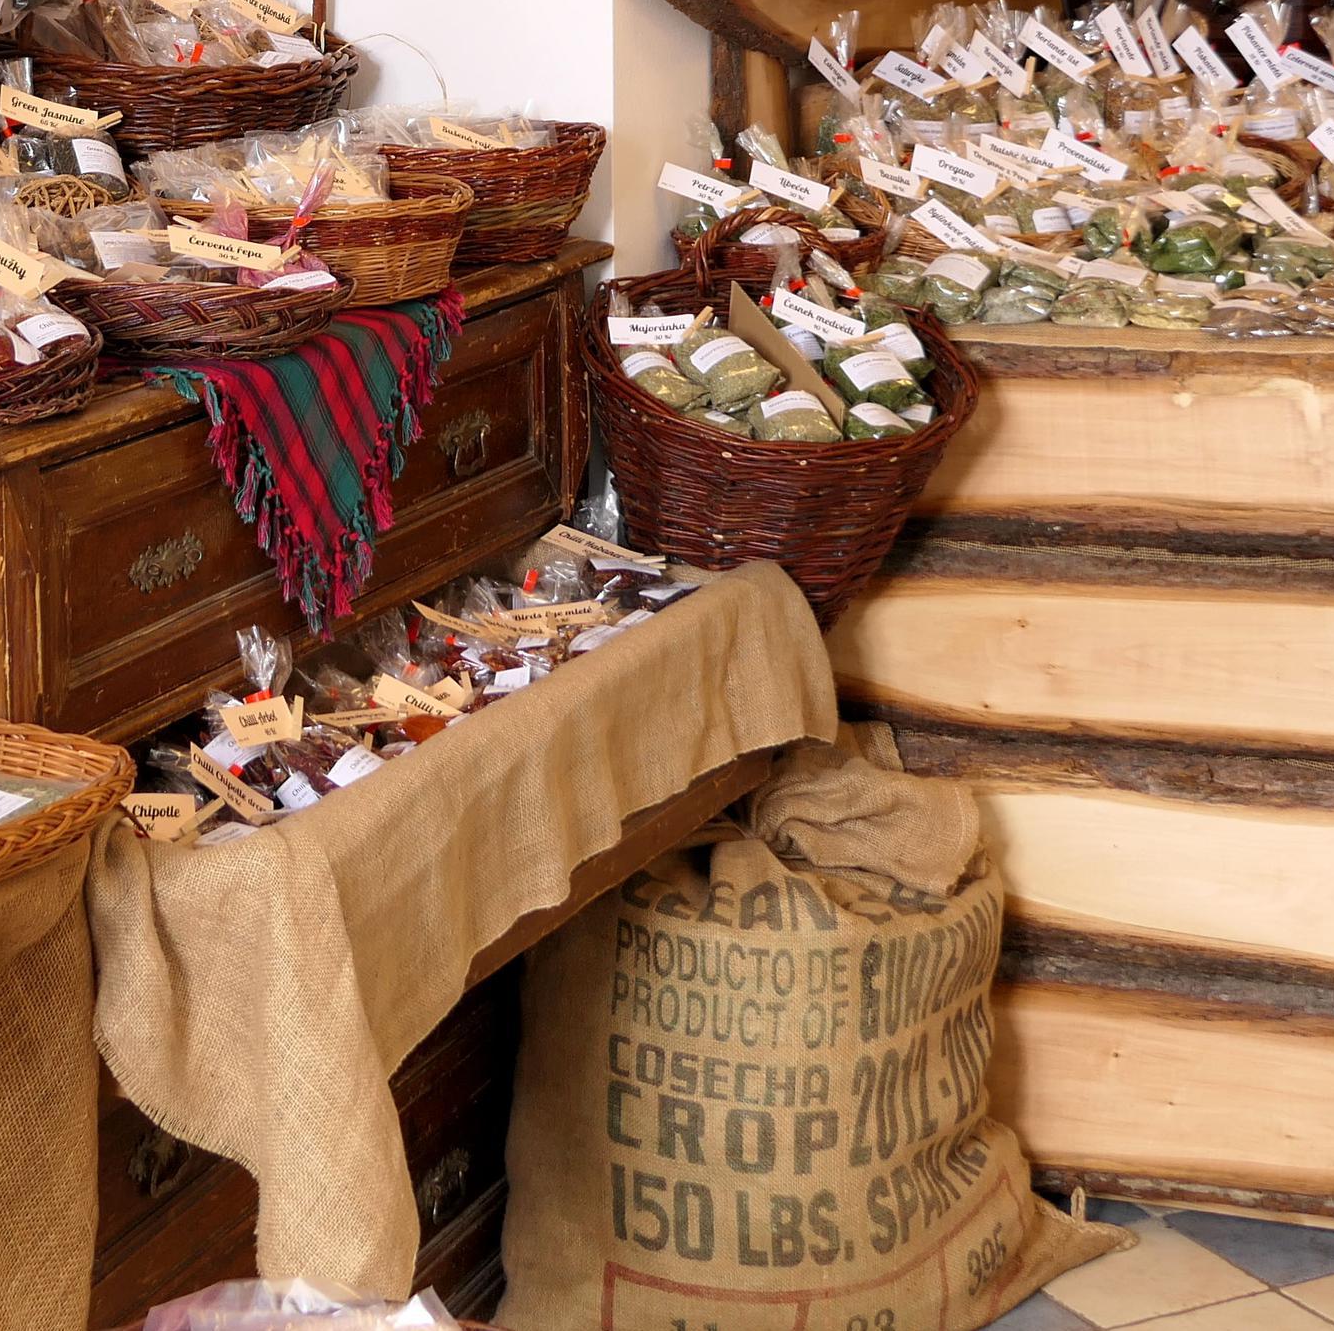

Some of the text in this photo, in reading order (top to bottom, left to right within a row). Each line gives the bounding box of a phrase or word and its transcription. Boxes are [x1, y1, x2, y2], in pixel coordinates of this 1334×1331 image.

[259, 0, 292, 26] cejlonská
[1034, 28, 1067, 58] Koriandr
[10, 96, 86, 127] Green Jasmine
[879, 169, 911, 187] Bazalka
[938, 158, 976, 180] Oregano
[691, 178, 725, 199] Petržel
[778, 176, 811, 197] Libeček
[186, 233, 265, 261] Červená řepa
[628, 321, 687, 335] Majoránka
[782, 296, 855, 338] Česnek medvědí
[558, 528, 586, 547] Chilli
[513, 604, 594, 624] Birds mleté
[404, 691, 434, 714] Chilli
[237, 712, 256, 728] Chilli
[192, 750, 248, 801] Chilli Chipotle
[132, 803, 182, 823] Chipotle
[615, 916, 850, 998] PRODUCTO DE
[610, 971, 849, 1050] PRODUCT OF
[607, 1032, 830, 1107] COSECHA
[606, 1080, 840, 1176] CROP
[609, 1162, 857, 1269] 150 LBS.
